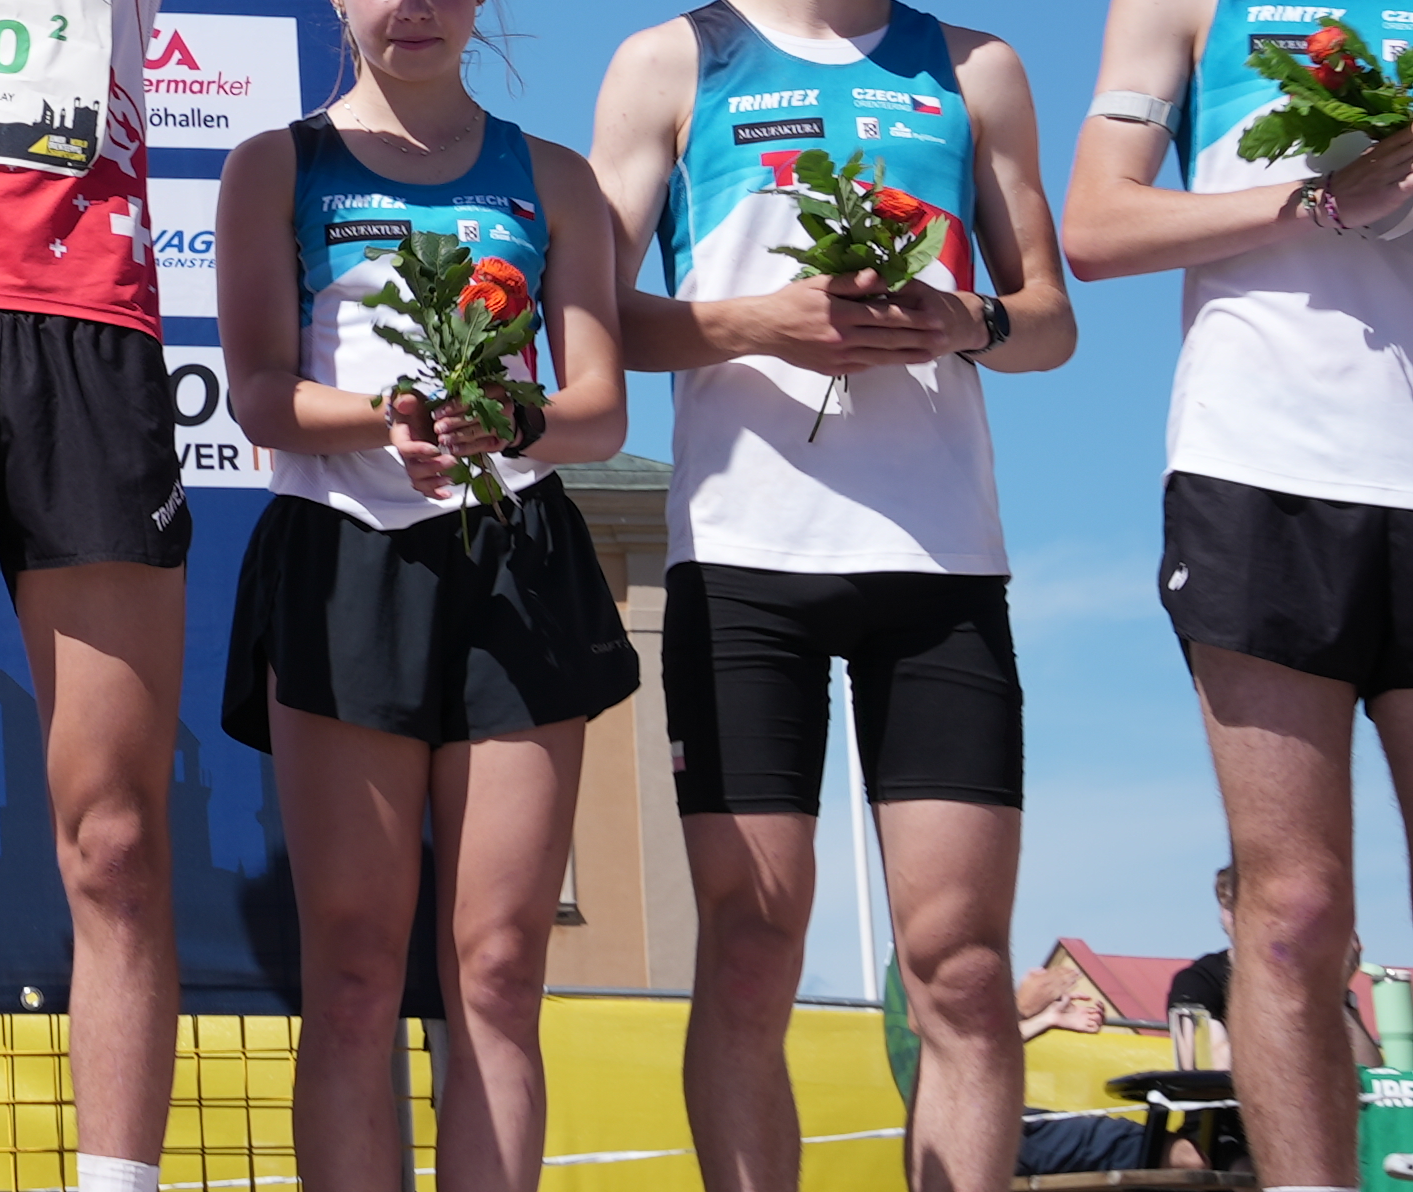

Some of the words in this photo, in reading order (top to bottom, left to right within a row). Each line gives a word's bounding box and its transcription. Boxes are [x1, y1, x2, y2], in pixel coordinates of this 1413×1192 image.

[49, 14, 69, 42] 2
[728, 89, 821, 114] TRIMTEX
[852, 88, 912, 105] CZECH
[321, 194, 408, 213] TRIMTEX
[452, 195, 510, 208] CZECH
